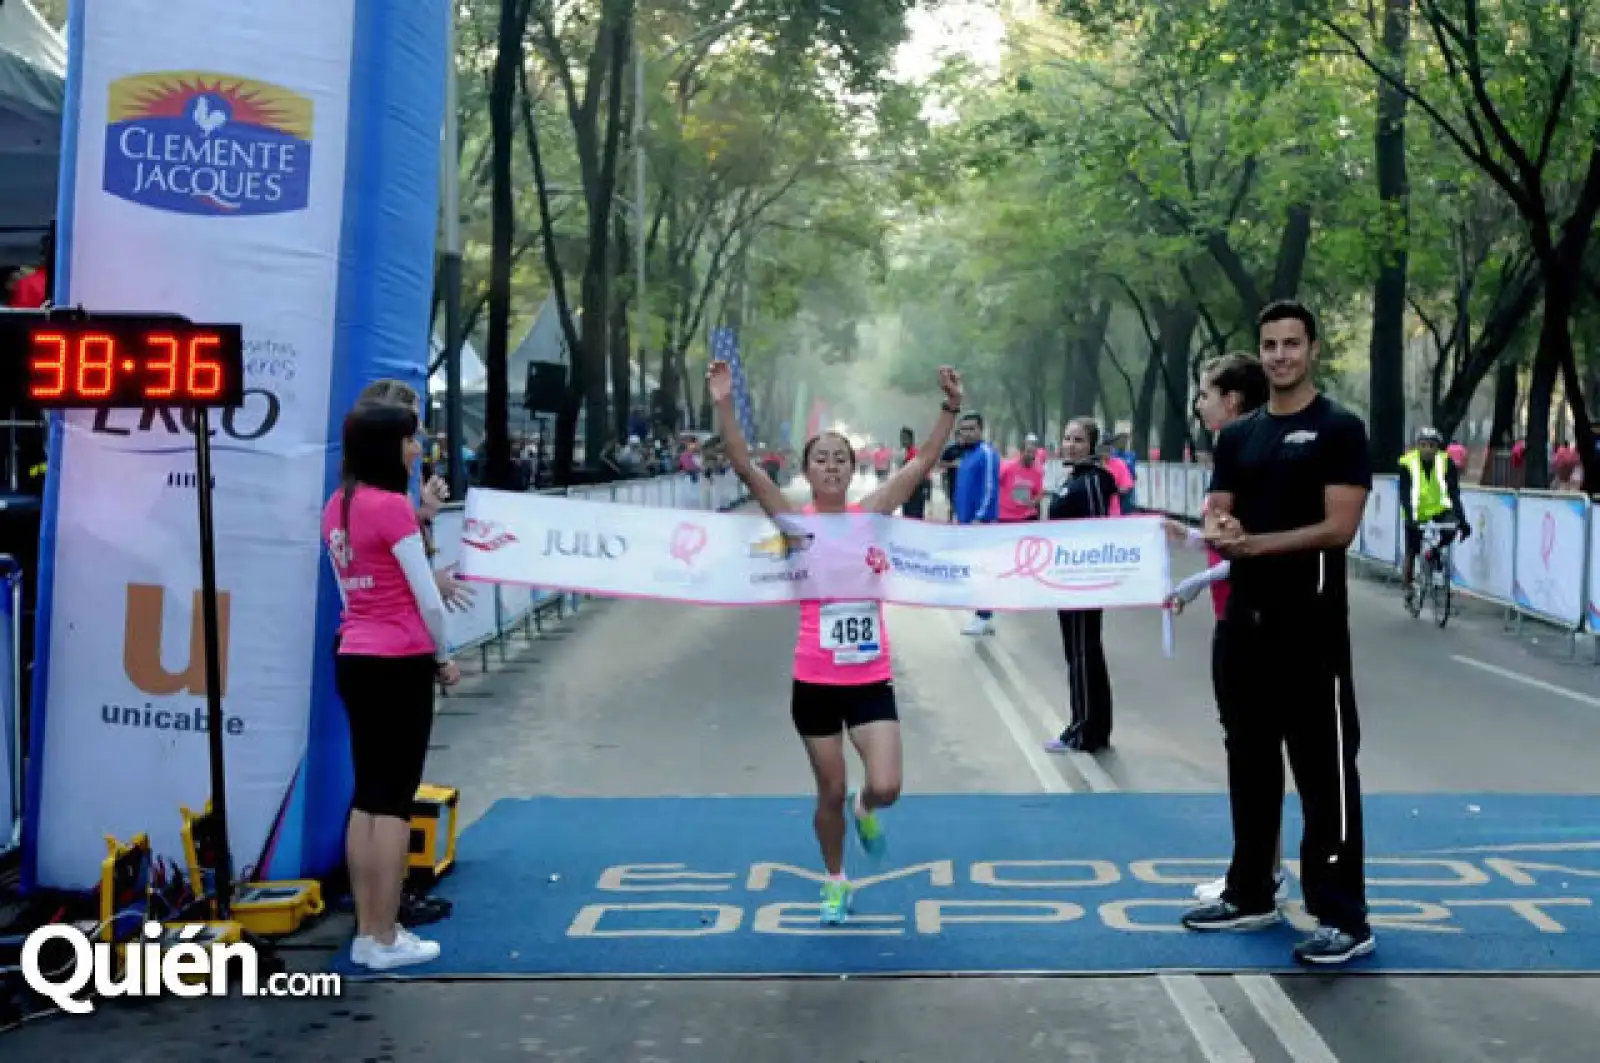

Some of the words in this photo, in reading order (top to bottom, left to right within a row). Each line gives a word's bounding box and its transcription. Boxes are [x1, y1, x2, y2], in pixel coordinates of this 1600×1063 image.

[119, 126, 296, 172] CLEMENTE
[133, 162, 281, 209] JACQUES
[541, 529, 629, 560] JULIO
[1054, 543, 1141, 566] huellas
[832, 617, 874, 645] 468
